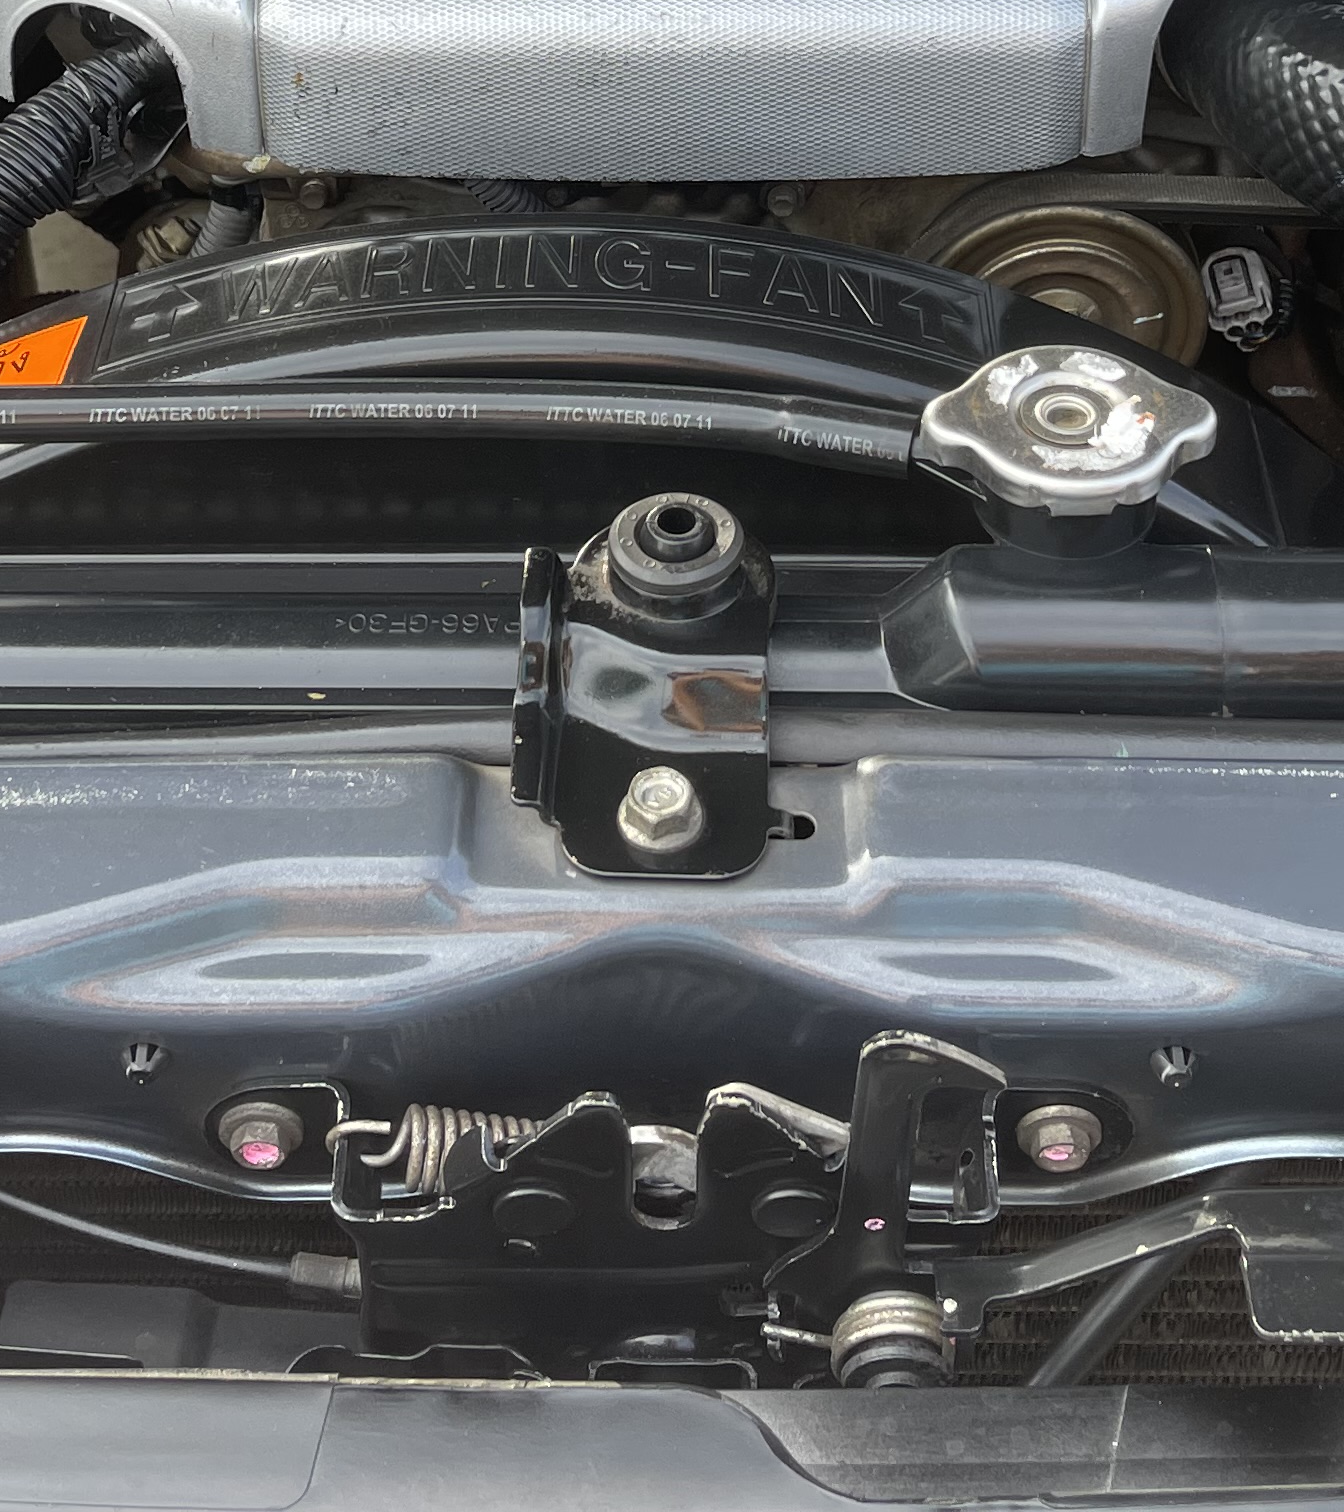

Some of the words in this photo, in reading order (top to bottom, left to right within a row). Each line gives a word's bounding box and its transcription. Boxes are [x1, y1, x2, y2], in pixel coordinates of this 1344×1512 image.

[220, 236, 885, 324] WARNING-FAN
[129, 406, 193, 422] WATER
[196, 406, 217, 421] 06
[350, 403, 411, 419] WATER
[414, 404, 434, 419] 06
[437, 404, 455, 419] 07
[460, 404, 478, 419] 11
[586, 407, 647, 426] WATER
[650, 411, 669, 427] 06
[672, 413, 691, 429] 07
[695, 414, 713, 431] 11
[816, 431, 874, 457] WATER
